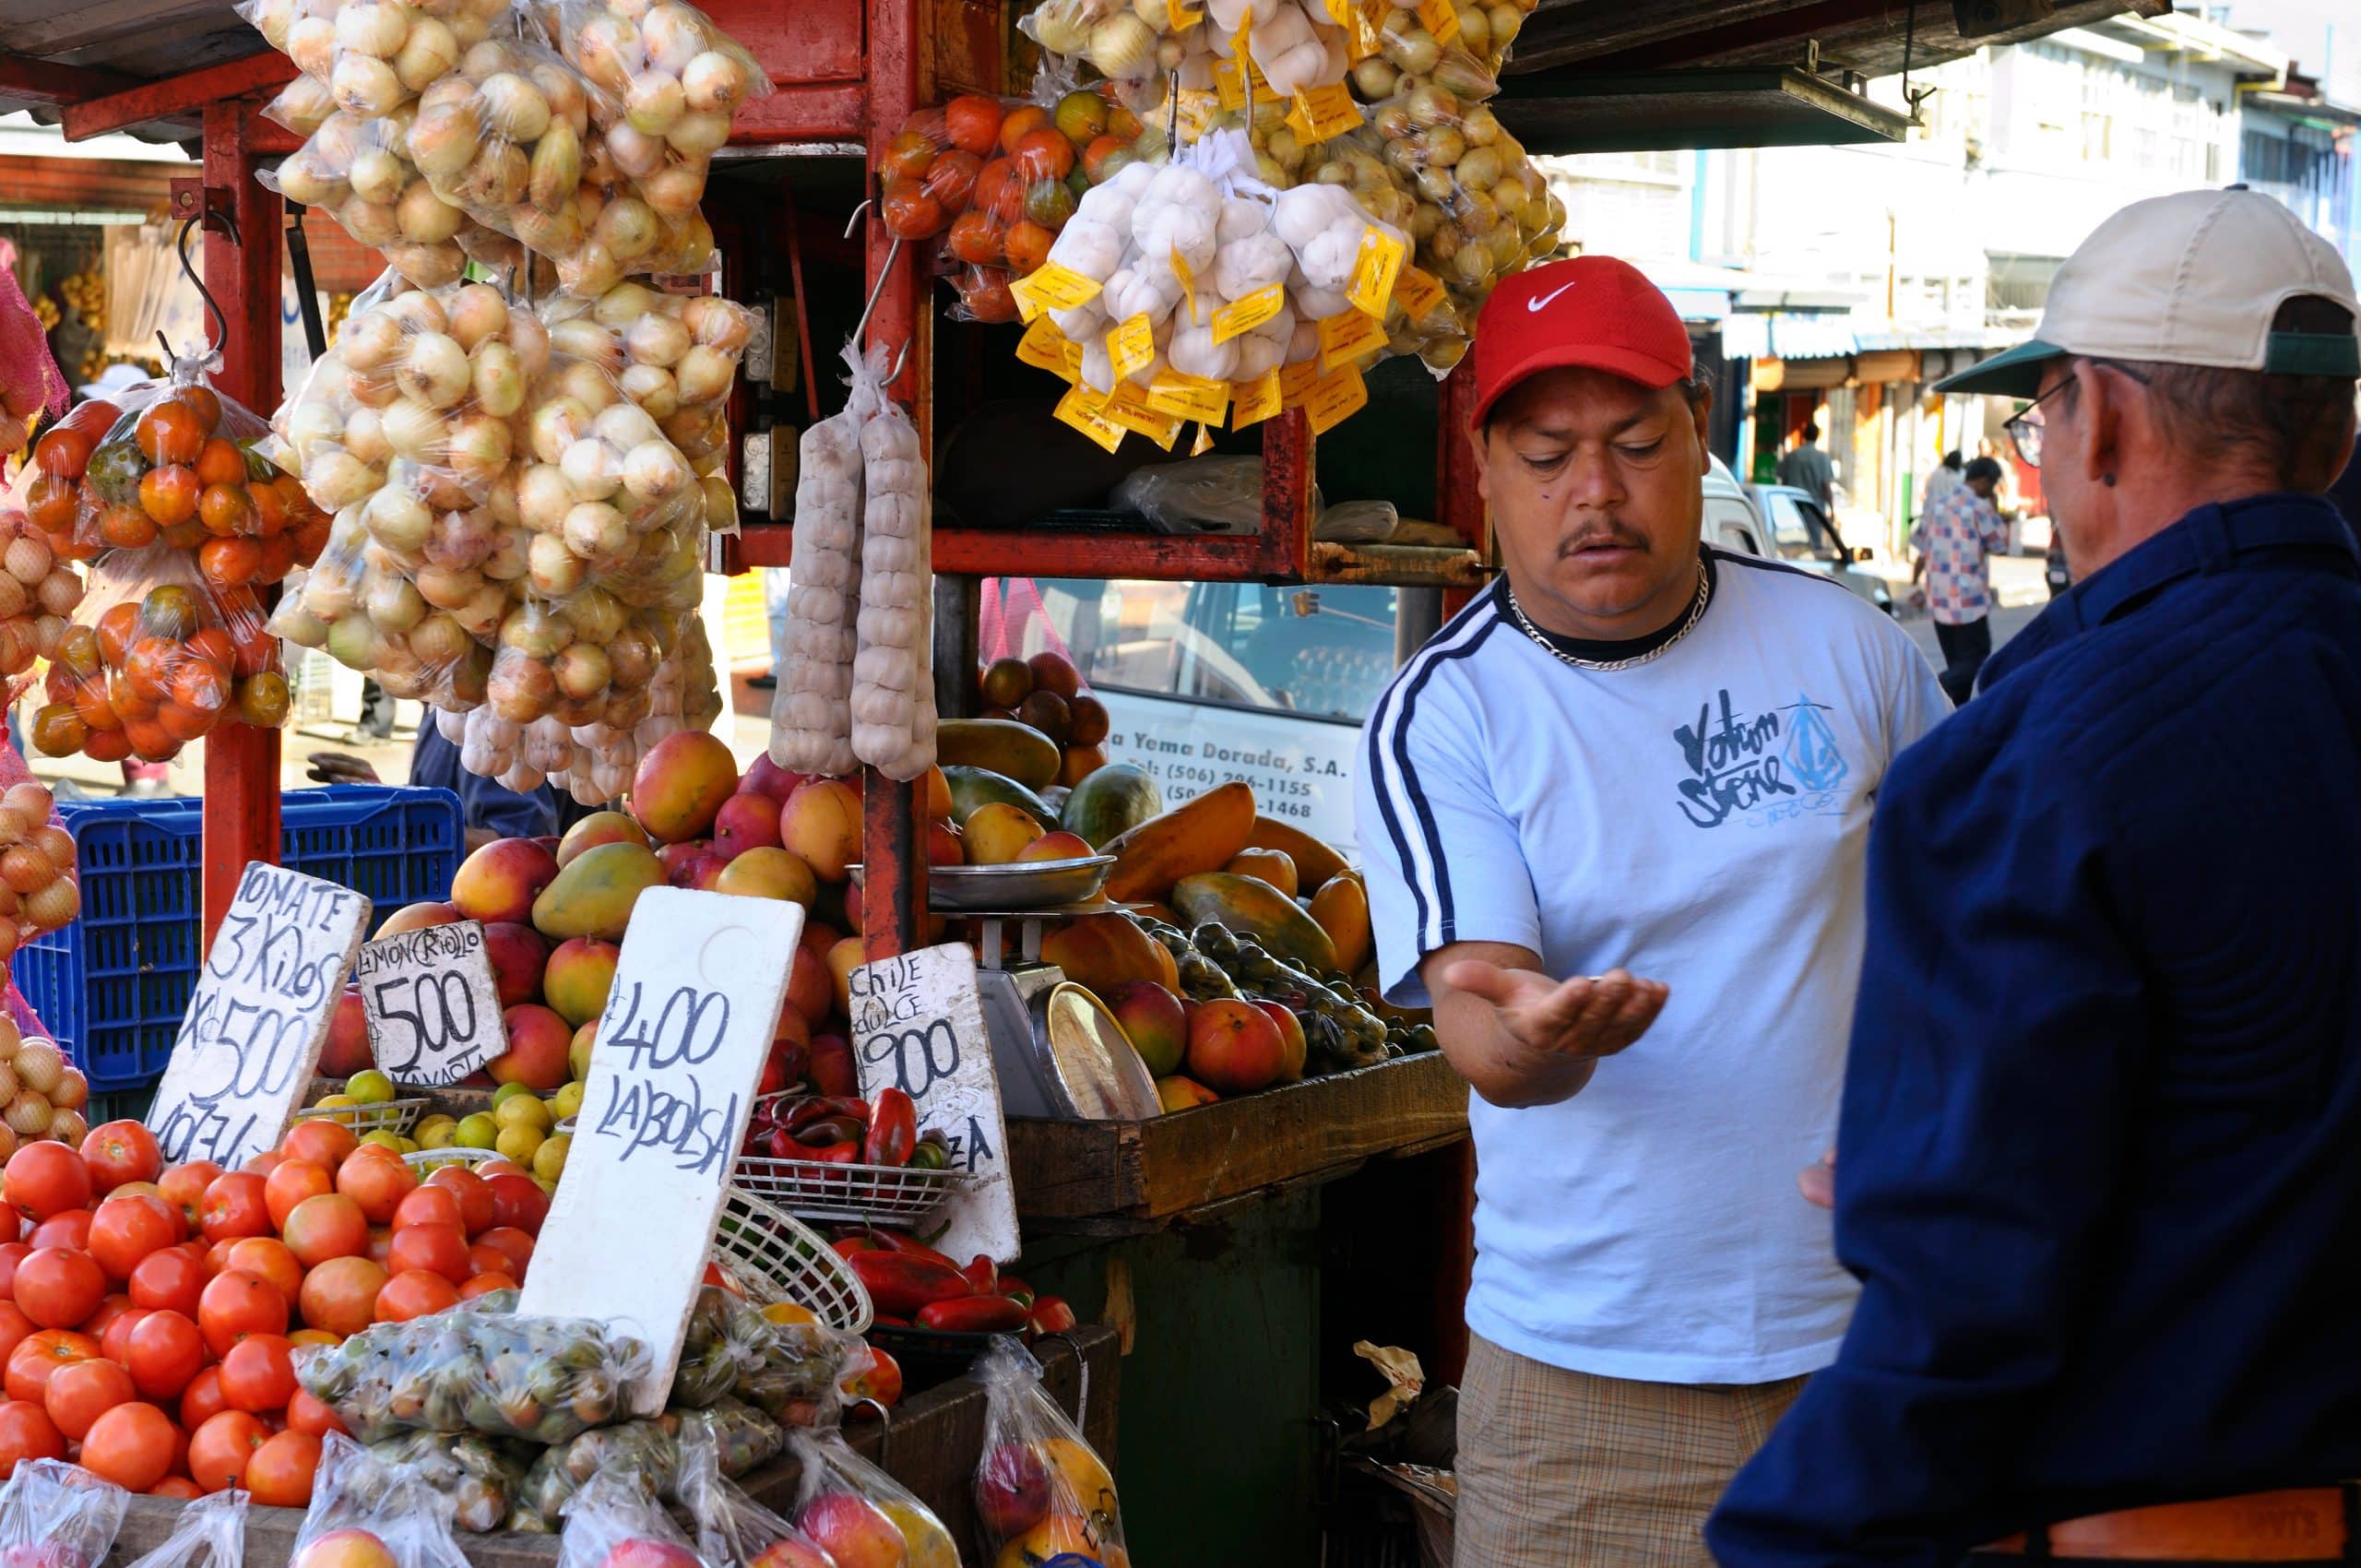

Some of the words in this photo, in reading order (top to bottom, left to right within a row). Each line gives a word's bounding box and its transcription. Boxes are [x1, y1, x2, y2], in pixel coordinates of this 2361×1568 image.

[1111, 733, 1123, 746] a
[1134, 732, 1194, 755] Yema
[1203, 742, 1295, 773] Dorada,
[1303, 757, 1347, 778] S.A.
[1167, 764, 1216, 785] (506)
[1223, 772, 1311, 797] 296-1155
[1257, 796, 1311, 818] -1468
[238, 862, 350, 932] TOMATE
[208, 914, 258, 980] 3
